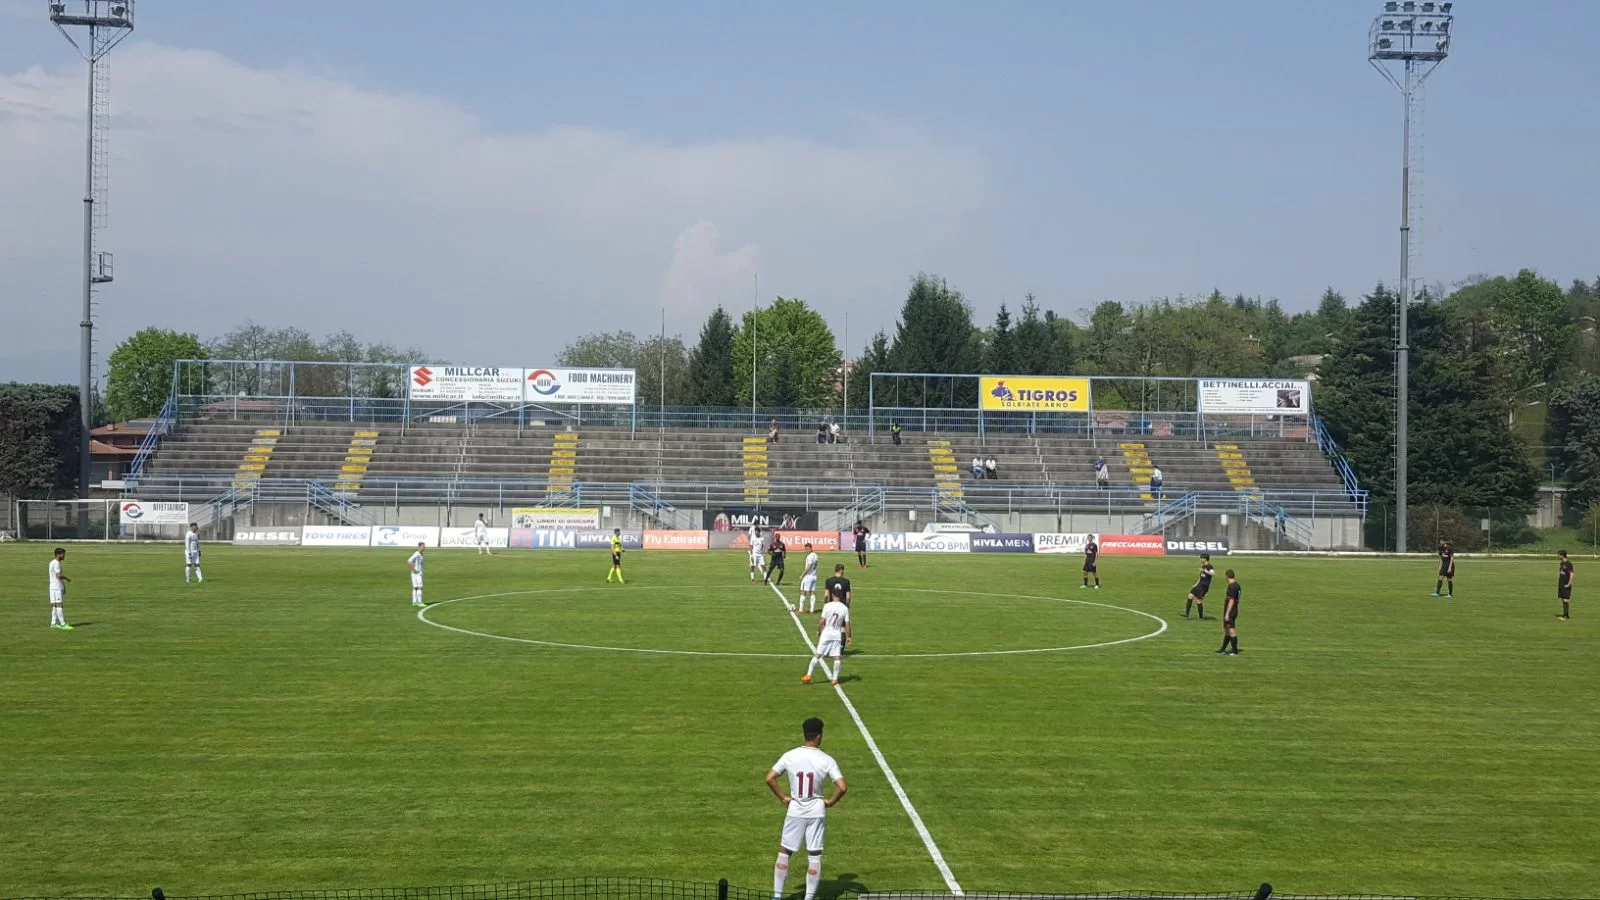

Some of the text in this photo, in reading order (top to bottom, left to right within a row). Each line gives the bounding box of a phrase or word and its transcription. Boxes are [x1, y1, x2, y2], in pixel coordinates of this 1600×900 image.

[445, 367, 499, 376] MILLCAR
[568, 372, 634, 384] FOOD MACHINERY
[1017, 389, 1077, 402] TIGROS
[731, 514, 769, 525] MILAN
[235, 532, 300, 541] DIESEL
[304, 532, 368, 540] TOYO TIRES
[402, 532, 427, 541] Group
[535, 530, 576, 548] TIM
[621, 535, 639, 543] EN
[645, 534, 706, 545] Fly Emirates
[795, 535, 838, 545] Emirates
[907, 541, 969, 550] BANCO BPM
[973, 539, 1004, 547] NIVEA
[1101, 541, 1163, 549] FRECCIAROSSA
[1167, 541, 1227, 550] DIESEL
[796, 771, 815, 798] 11
